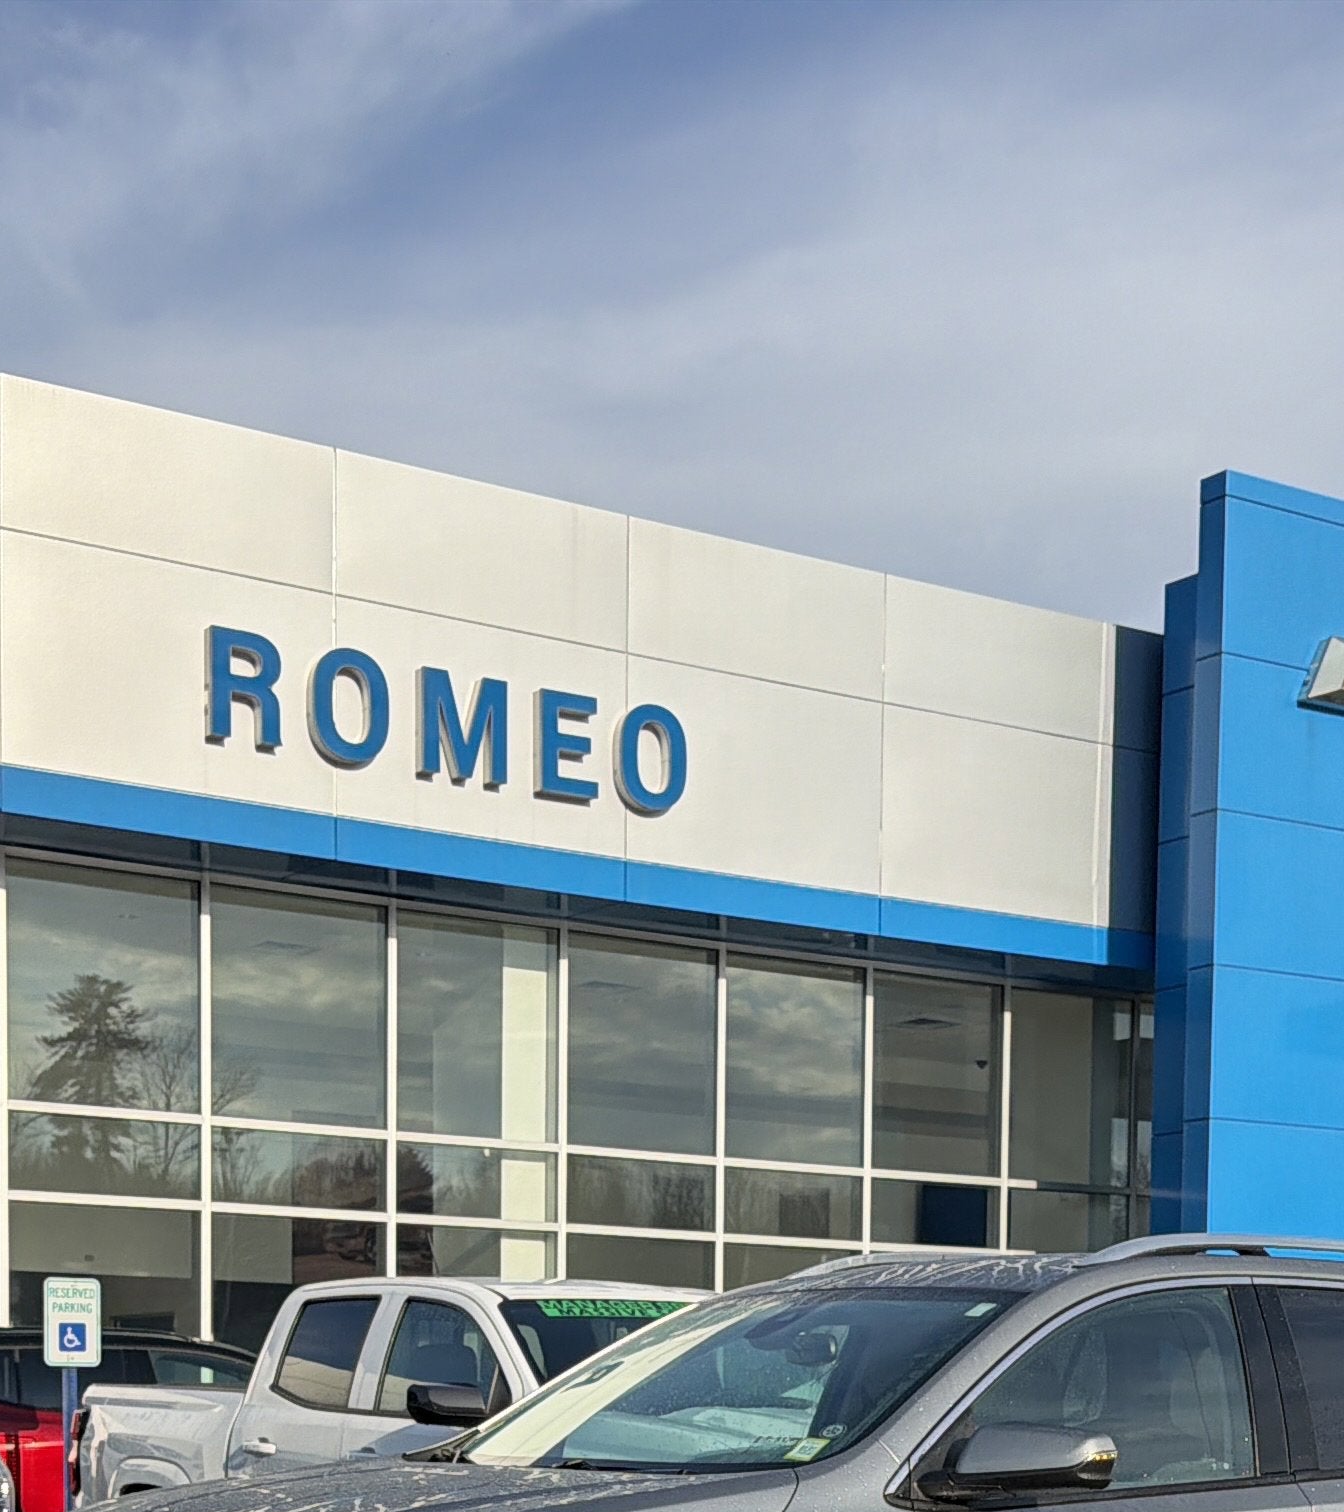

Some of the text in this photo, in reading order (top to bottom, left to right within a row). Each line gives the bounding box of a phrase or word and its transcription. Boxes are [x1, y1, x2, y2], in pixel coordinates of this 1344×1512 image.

[205, 625, 688, 815] ROMEO
[48, 1287, 96, 1299] RESERVED
[52, 1301, 93, 1314] PARKING
